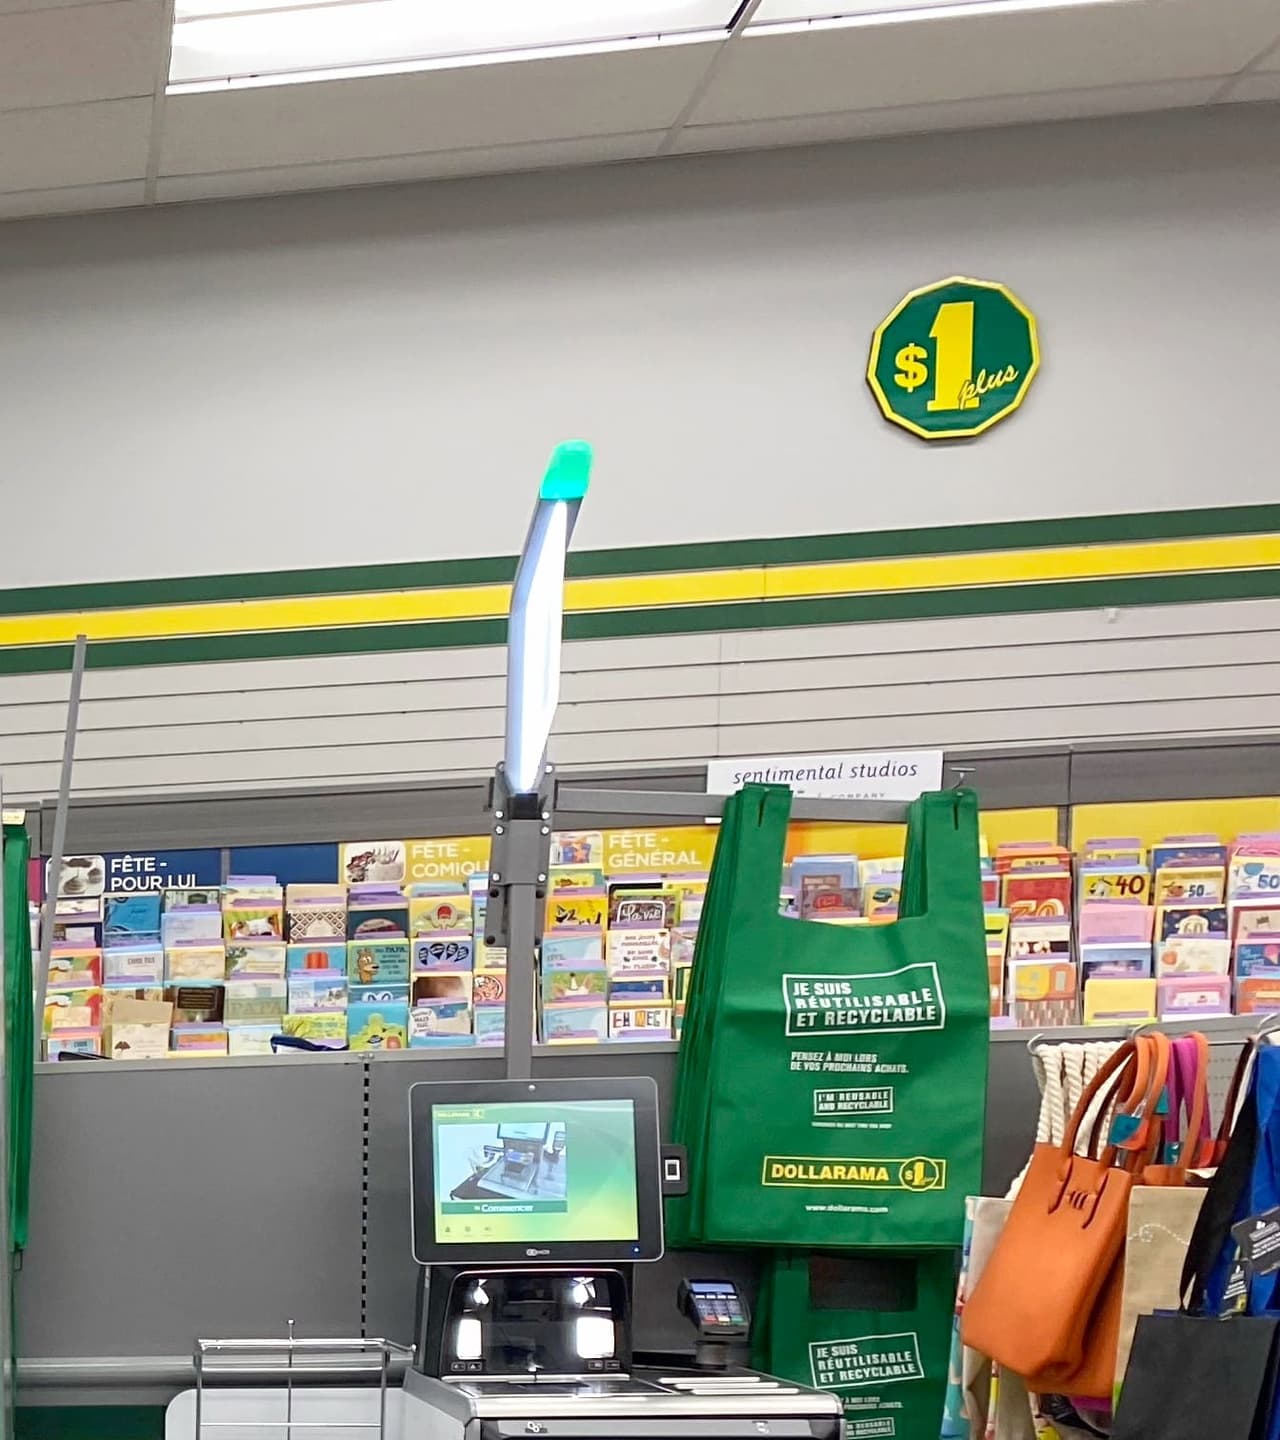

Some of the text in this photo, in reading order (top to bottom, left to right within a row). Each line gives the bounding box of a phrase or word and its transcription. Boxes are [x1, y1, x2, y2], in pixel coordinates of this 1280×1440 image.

[895, 301, 980, 411] $1
[958, 364, 1019, 410] plus
[733, 761, 919, 785] sentimental studios
[609, 831, 656, 848] FÊTE
[412, 843, 458, 858] FÊTE
[609, 850, 702, 868] GÉNÉRAL
[111, 855, 156, 873] FÊTE
[412, 861, 489, 878] COMIQU
[111, 874, 197, 891] POUR LUI
[1116, 875, 1145, 895] 40
[1189, 884, 1205, 897] 50
[793, 982, 852, 996] JE SUIS
[795, 988, 933, 1009] RÉUTILISABLE
[796, 1006, 936, 1027] ET RECYCLABLE
[790, 1062, 802, 1071] DE
[804, 1062, 821, 1072] VOS
[772, 1164, 889, 1181] DOLLARAMA
[816, 1344, 858, 1358] JE SUIS
[818, 1351, 912, 1371] RÉUTILISABLE
[820, 1364, 916, 1383] ET RECYCLABLE
